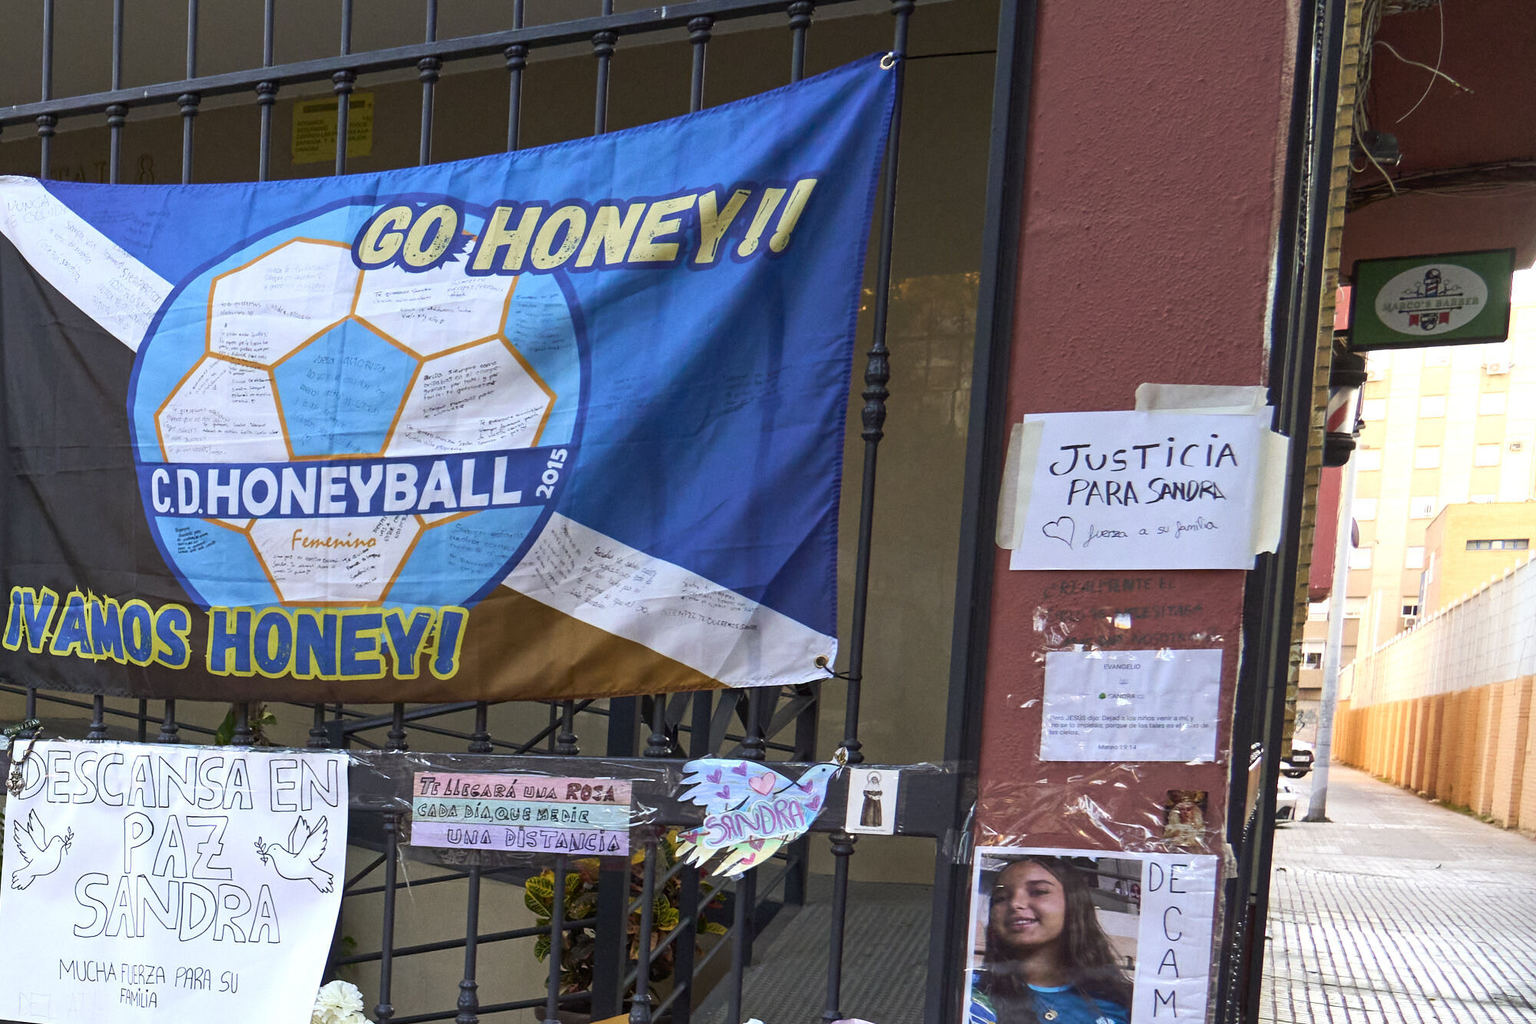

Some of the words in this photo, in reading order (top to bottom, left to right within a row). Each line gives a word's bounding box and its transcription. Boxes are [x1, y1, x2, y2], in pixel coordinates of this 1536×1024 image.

[360, 207, 467, 269] GO
[474, 178, 817, 270] HONEY!!
[1049, 433, 1238, 476] JUSTICIA
[534, 446, 569, 501] 2015
[1067, 478, 1139, 506] PARA
[1145, 477, 1226, 505] SANDRA
[292, 528, 377, 552] Femenino
[1082, 524, 1128, 548] fuerza
[1138, 528, 1149, 537] a
[1156, 524, 1170, 536] su
[1174, 516, 1219, 539] familia
[207, 606, 470, 682] HONEY!
[1103, 663, 1142, 671] EVANGELIO
[18, 750, 254, 810] DESCANSA
[268, 758, 339, 813] EN
[442, 778, 517, 800] LLEGARÁ
[523, 784, 559, 801] UNA
[565, 781, 616, 802] ROSA
[417, 803, 459, 820] CADA
[537, 806, 590, 824] MEDIE
[704, 800, 806, 838] SANDRA
[123, 811, 233, 881] PAZ
[446, 828, 492, 846] UNA
[505, 828, 621, 854] DISTANCIA
[1148, 861, 1188, 895] DE
[72, 872, 281, 944] SANDRA
[58, 958, 118, 983] MUCHA
[120, 961, 166, 986] FUERZA
[174, 966, 212, 991] PARA
[219, 970, 239, 994] SU
